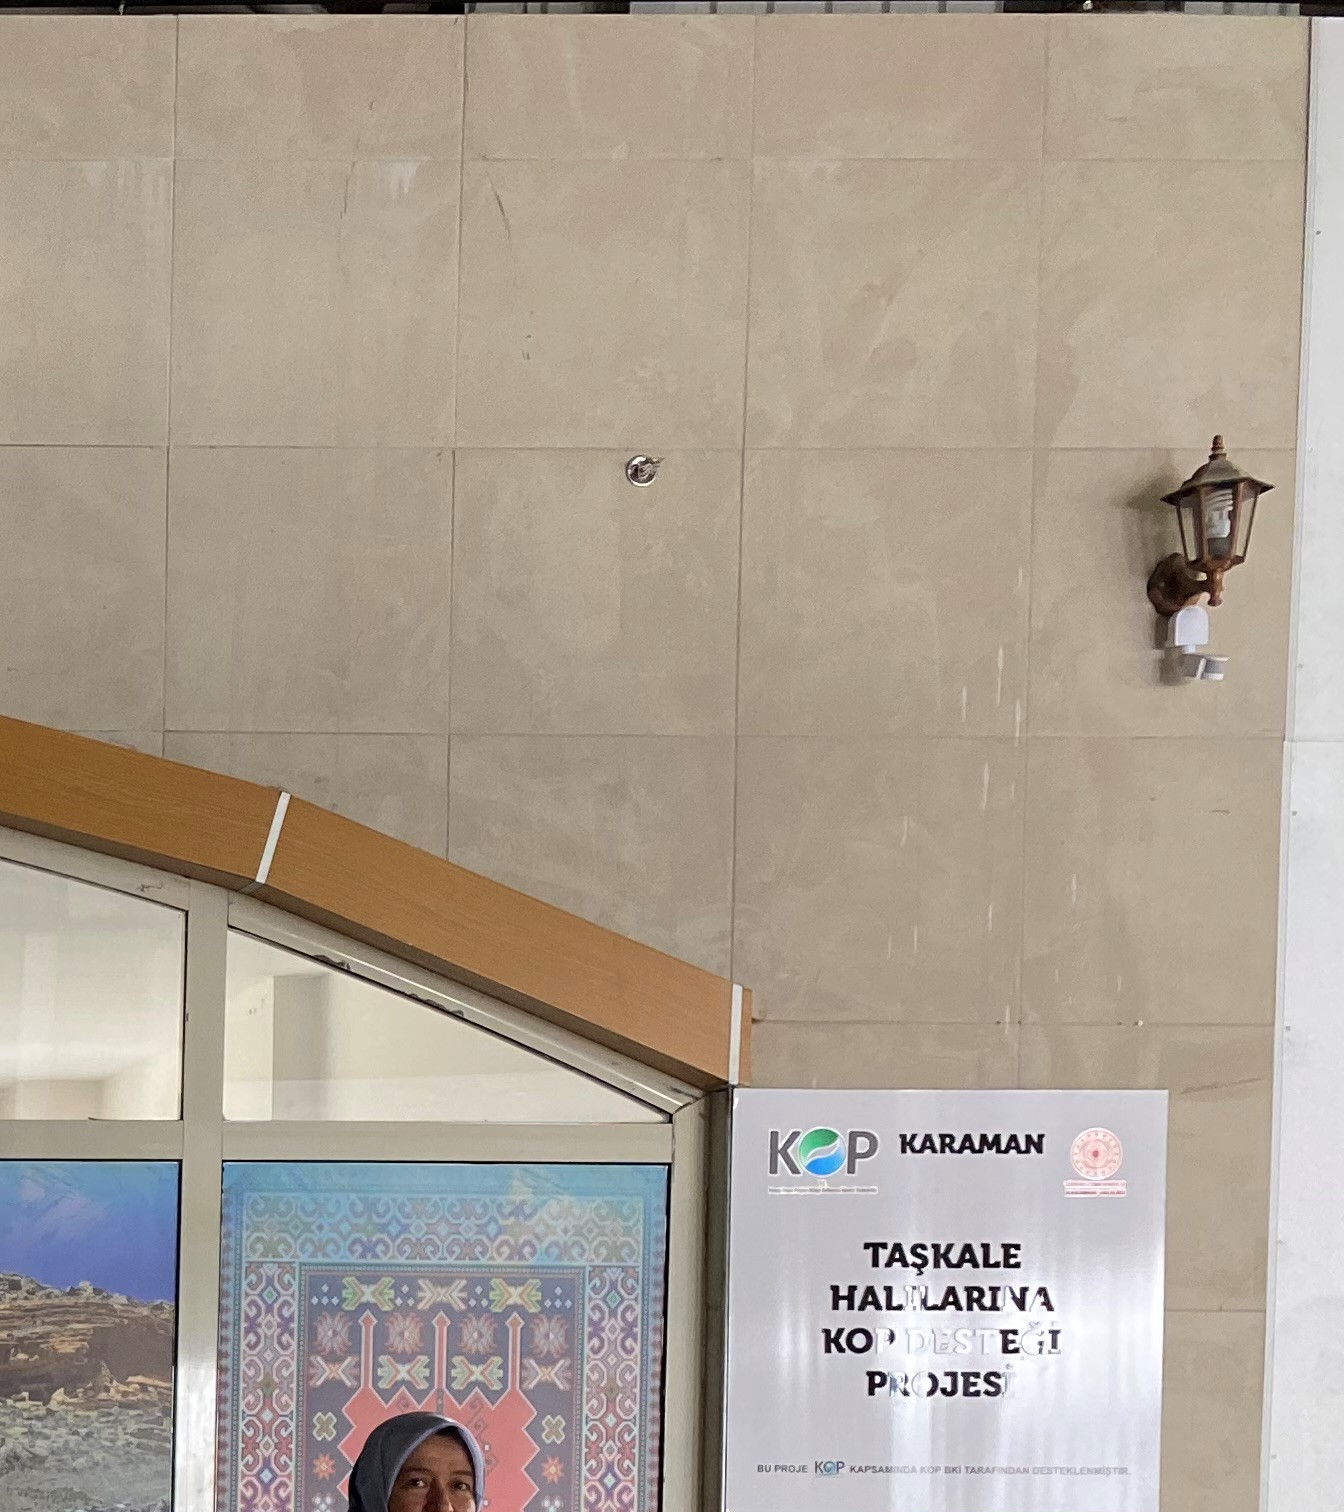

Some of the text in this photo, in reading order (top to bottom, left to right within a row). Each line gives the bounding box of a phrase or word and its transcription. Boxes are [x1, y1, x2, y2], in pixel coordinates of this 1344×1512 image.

[769, 1127, 879, 1176] KOP
[899, 1133, 1045, 1155] KARAMAN
[863, 1241, 1022, 1276] TAŞKALE
[821, 1327, 896, 1355] KOP
[757, 1464, 771, 1473] BU
[774, 1464, 808, 1473] PROJE
[814, 1460, 845, 1475] KOP
[964, 1466, 1030, 1475] TARAFINDAN
